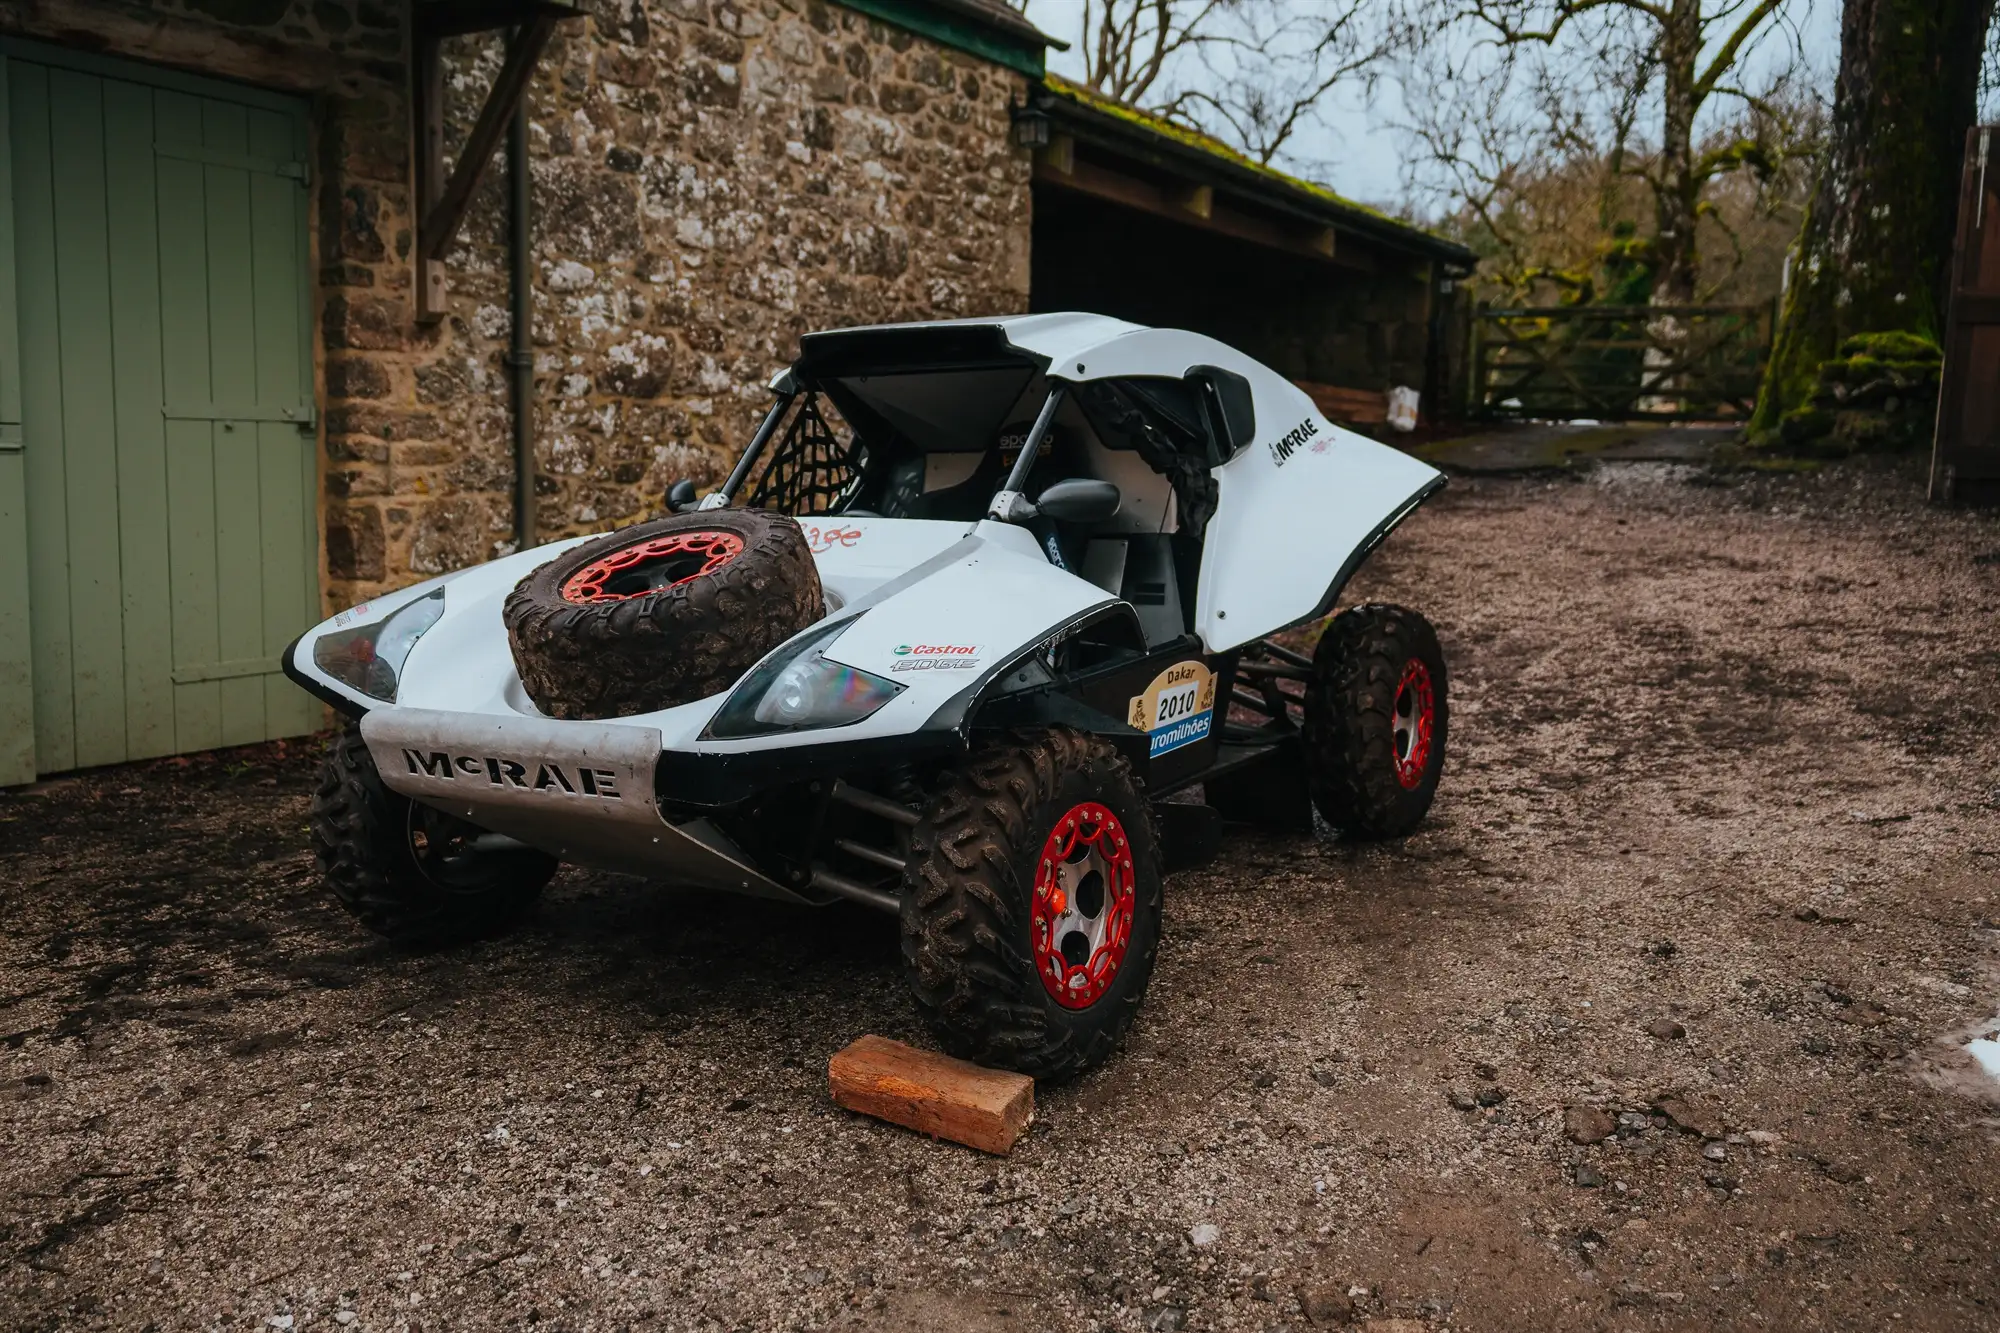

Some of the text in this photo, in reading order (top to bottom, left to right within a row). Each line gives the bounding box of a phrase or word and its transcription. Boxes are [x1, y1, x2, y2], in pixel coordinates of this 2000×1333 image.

[913, 644, 977, 655] Castrol
[890, 658, 980, 672] EDGE
[1167, 666, 1195, 685] Dakar
[1158, 689, 1195, 722] 2010
